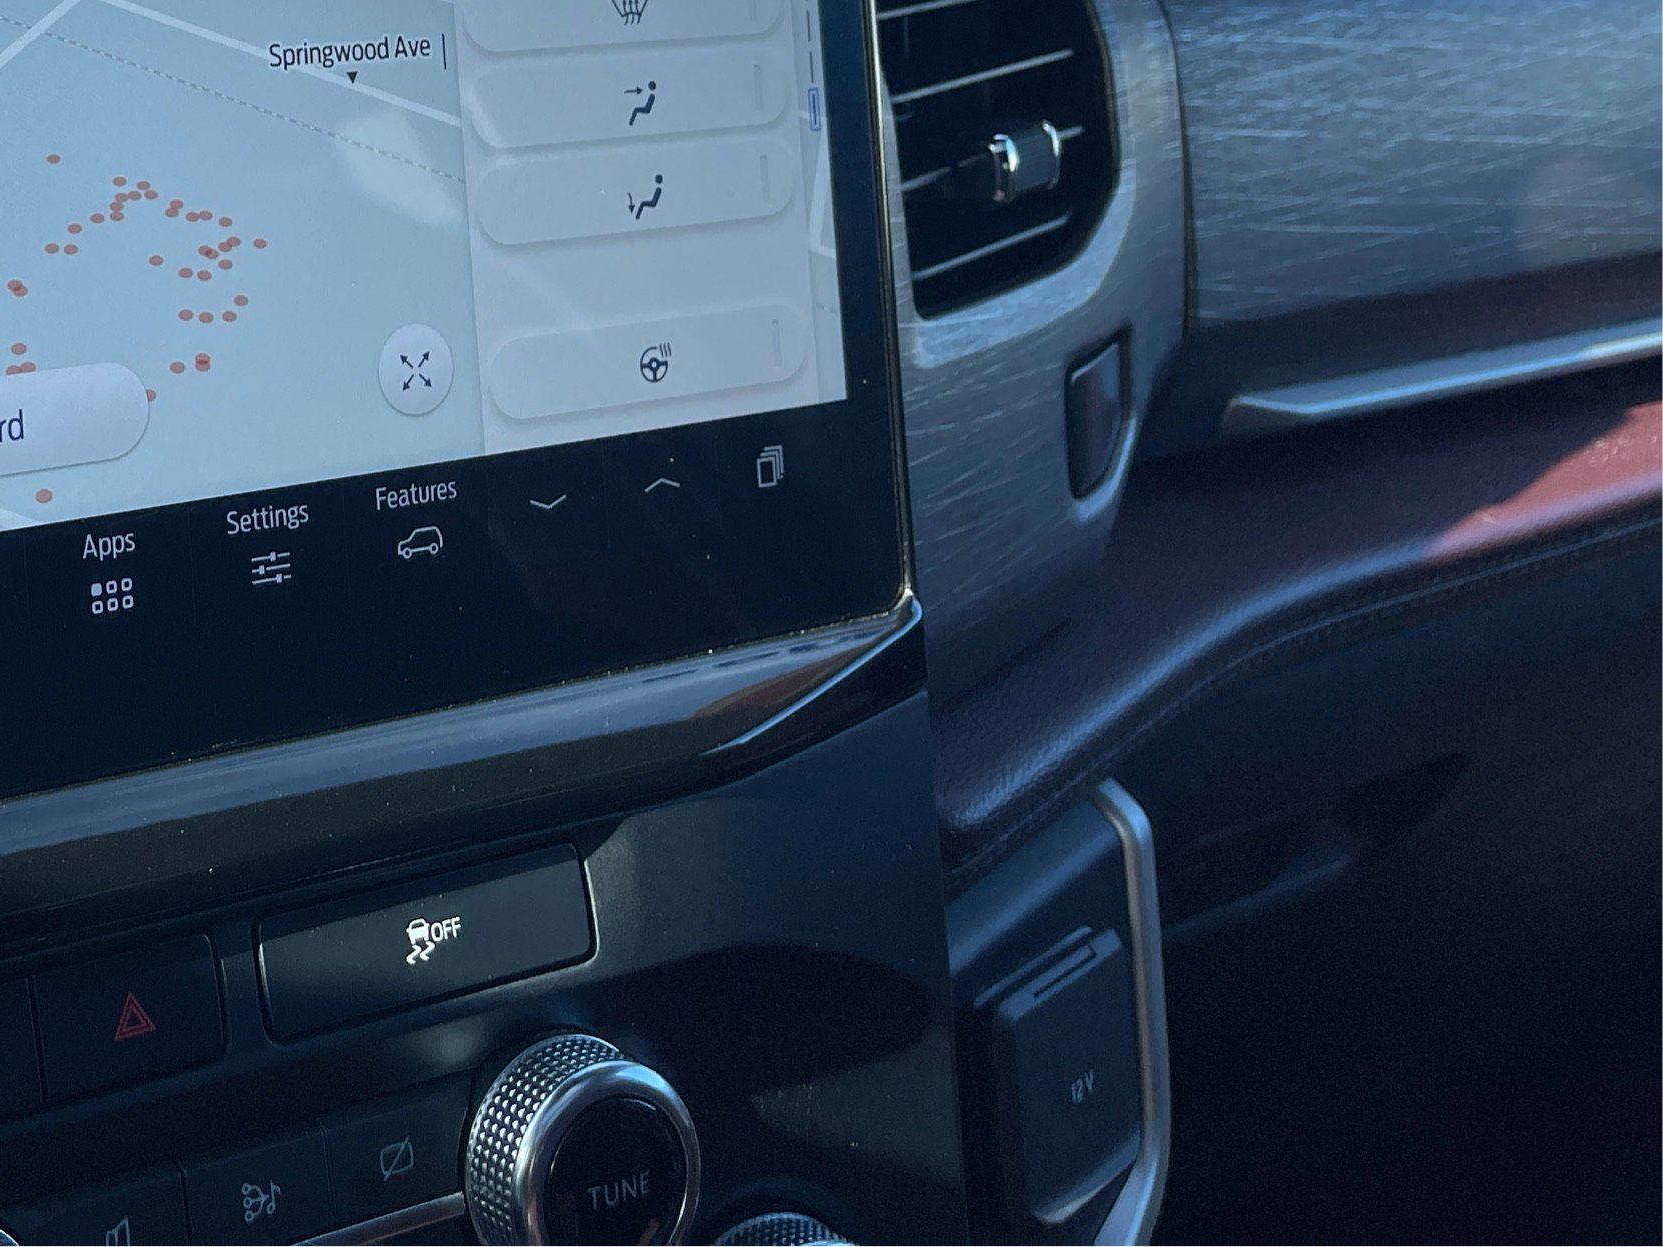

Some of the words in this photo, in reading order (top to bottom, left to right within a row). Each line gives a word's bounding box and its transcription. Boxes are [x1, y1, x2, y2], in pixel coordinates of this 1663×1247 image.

[269, 36, 390, 70] Springwood
[394, 36, 431, 59] Ave
[375, 479, 458, 510] Features
[226, 502, 310, 536] Settings
[83, 531, 136, 560] Apps
[431, 916, 461, 942] OFF
[1070, 1068, 1095, 1103] 12V
[587, 1171, 651, 1210] TUNE
